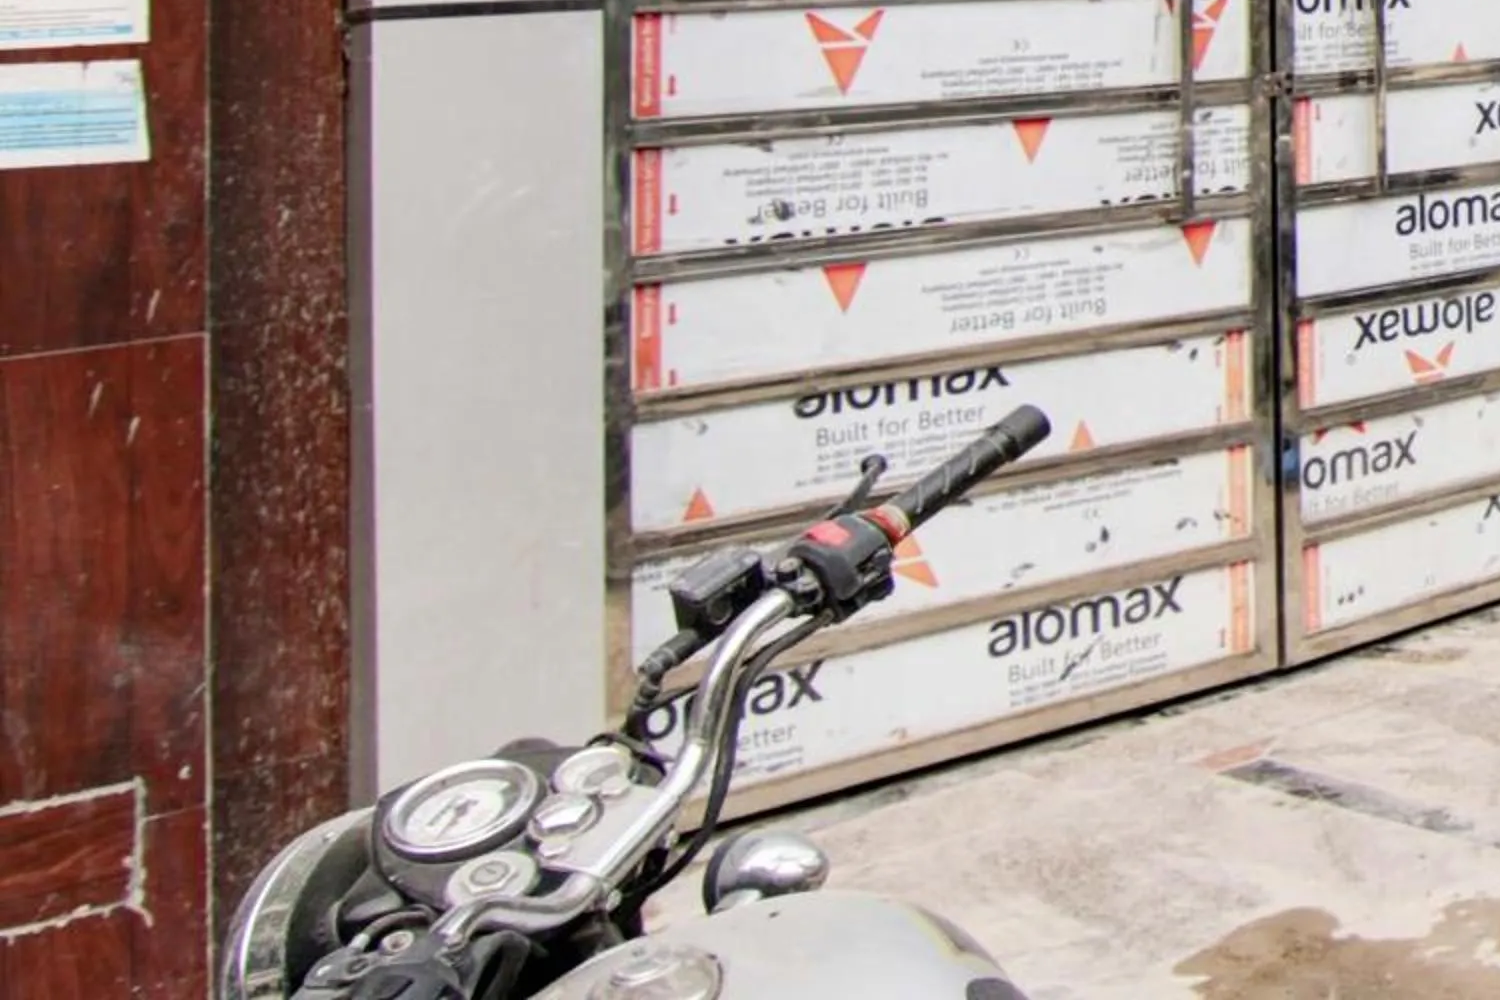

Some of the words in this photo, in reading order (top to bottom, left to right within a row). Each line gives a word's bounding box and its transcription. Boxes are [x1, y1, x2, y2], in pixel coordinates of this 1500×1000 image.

[1353, 291, 1495, 350] alomax
[815, 422, 869, 448] Built
[878, 417, 910, 436] for
[918, 405, 985, 430] Better
[988, 575, 1183, 658] alomax
[1008, 657, 1056, 684] Built
[1101, 632, 1162, 661] Better
[738, 725, 796, 748] etter
